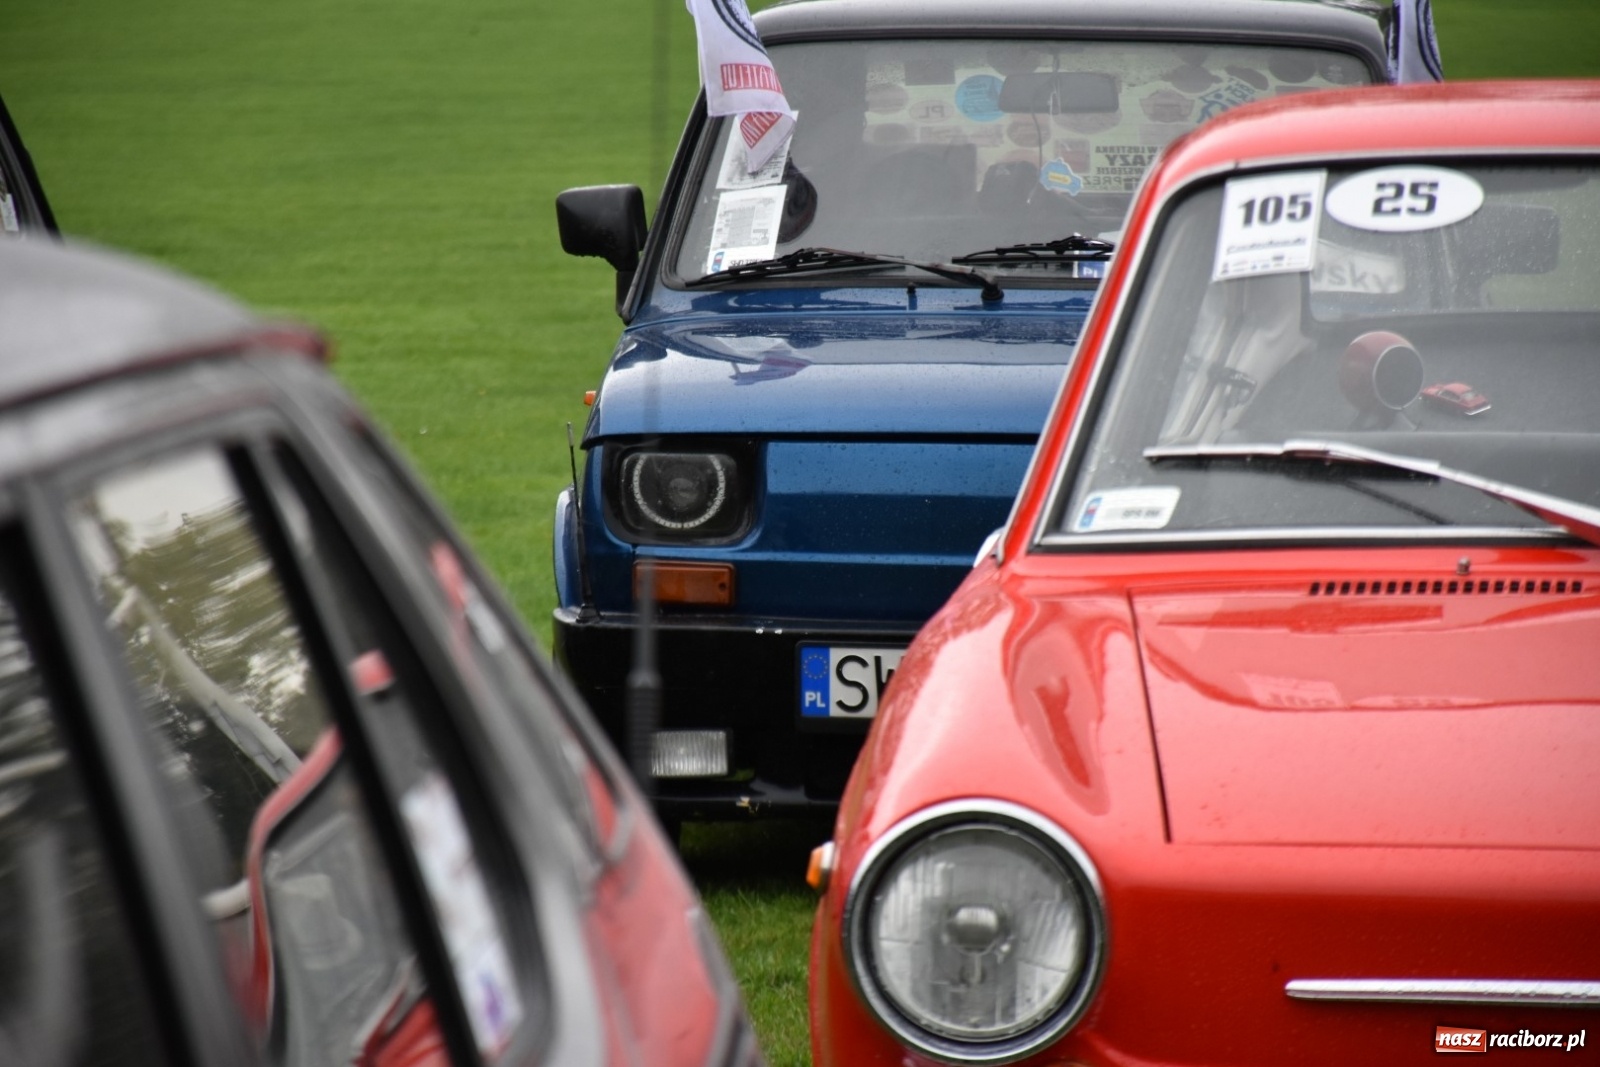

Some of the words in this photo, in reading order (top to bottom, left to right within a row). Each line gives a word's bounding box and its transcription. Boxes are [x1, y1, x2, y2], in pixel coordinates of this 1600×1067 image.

[1239, 193, 1312, 229] 105
[1372, 182, 1440, 217] 25
[804, 691, 826, 708] PL
